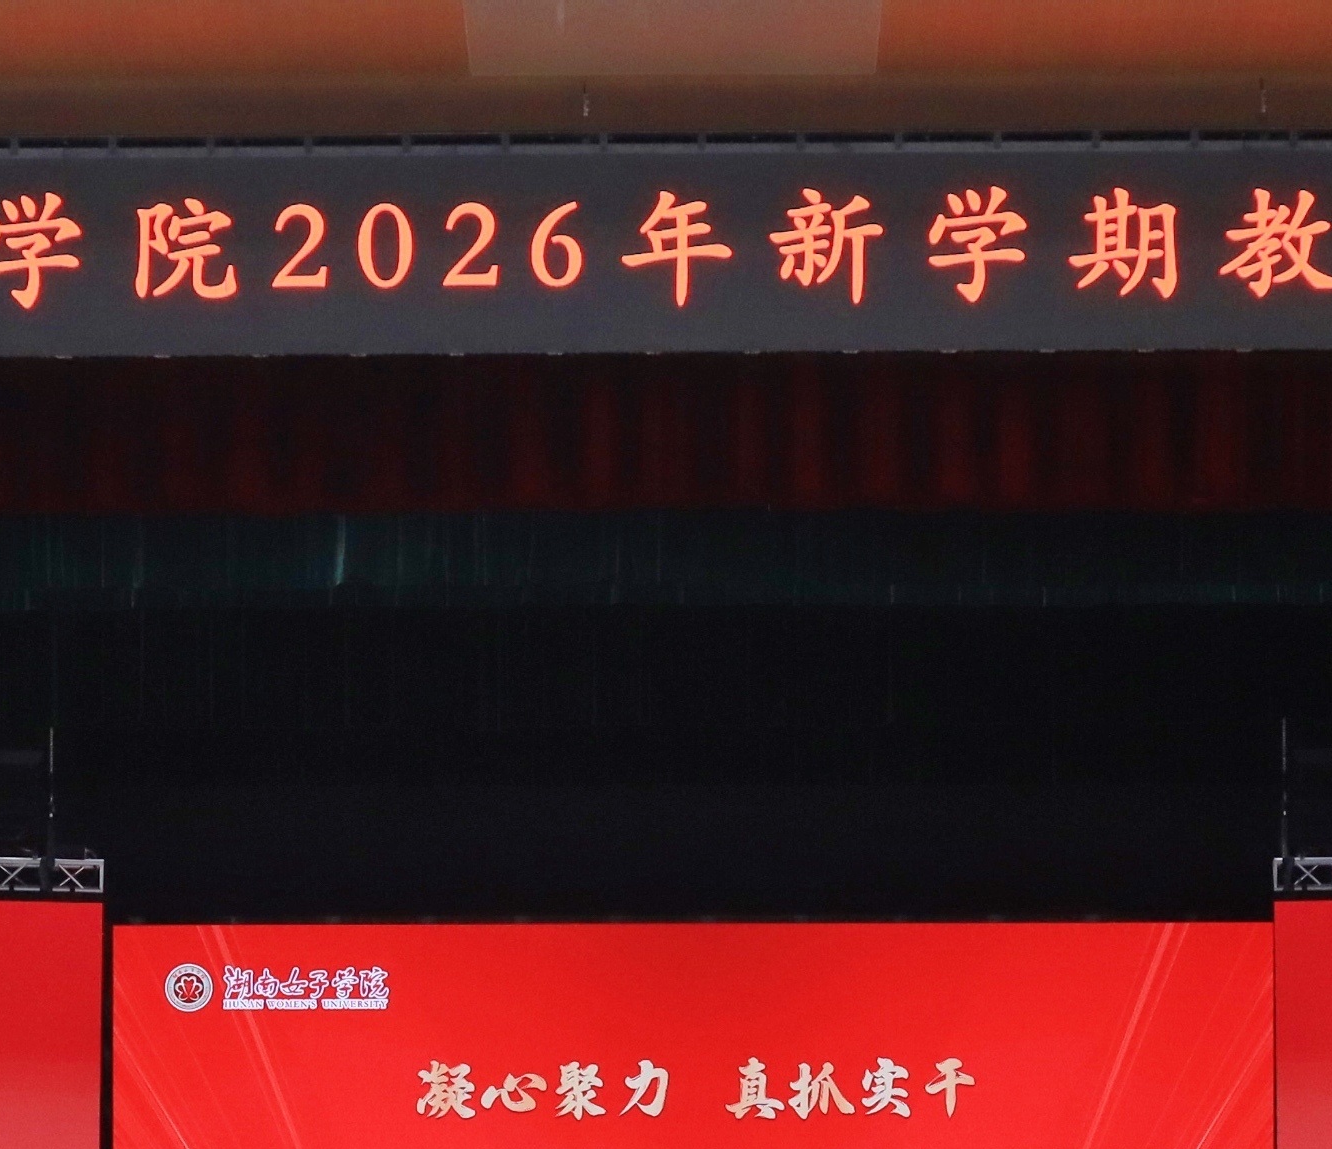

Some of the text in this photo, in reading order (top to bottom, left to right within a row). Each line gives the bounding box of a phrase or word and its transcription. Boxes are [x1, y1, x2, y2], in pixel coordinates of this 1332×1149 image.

[222, 965, 390, 999] 湖南女子学院
[223, 999, 264, 1009] HUNAN
[322, 999, 388, 1009] UNIVERSITY
[415, 1056, 976, 1121] 凝心聚力 真抓实干
